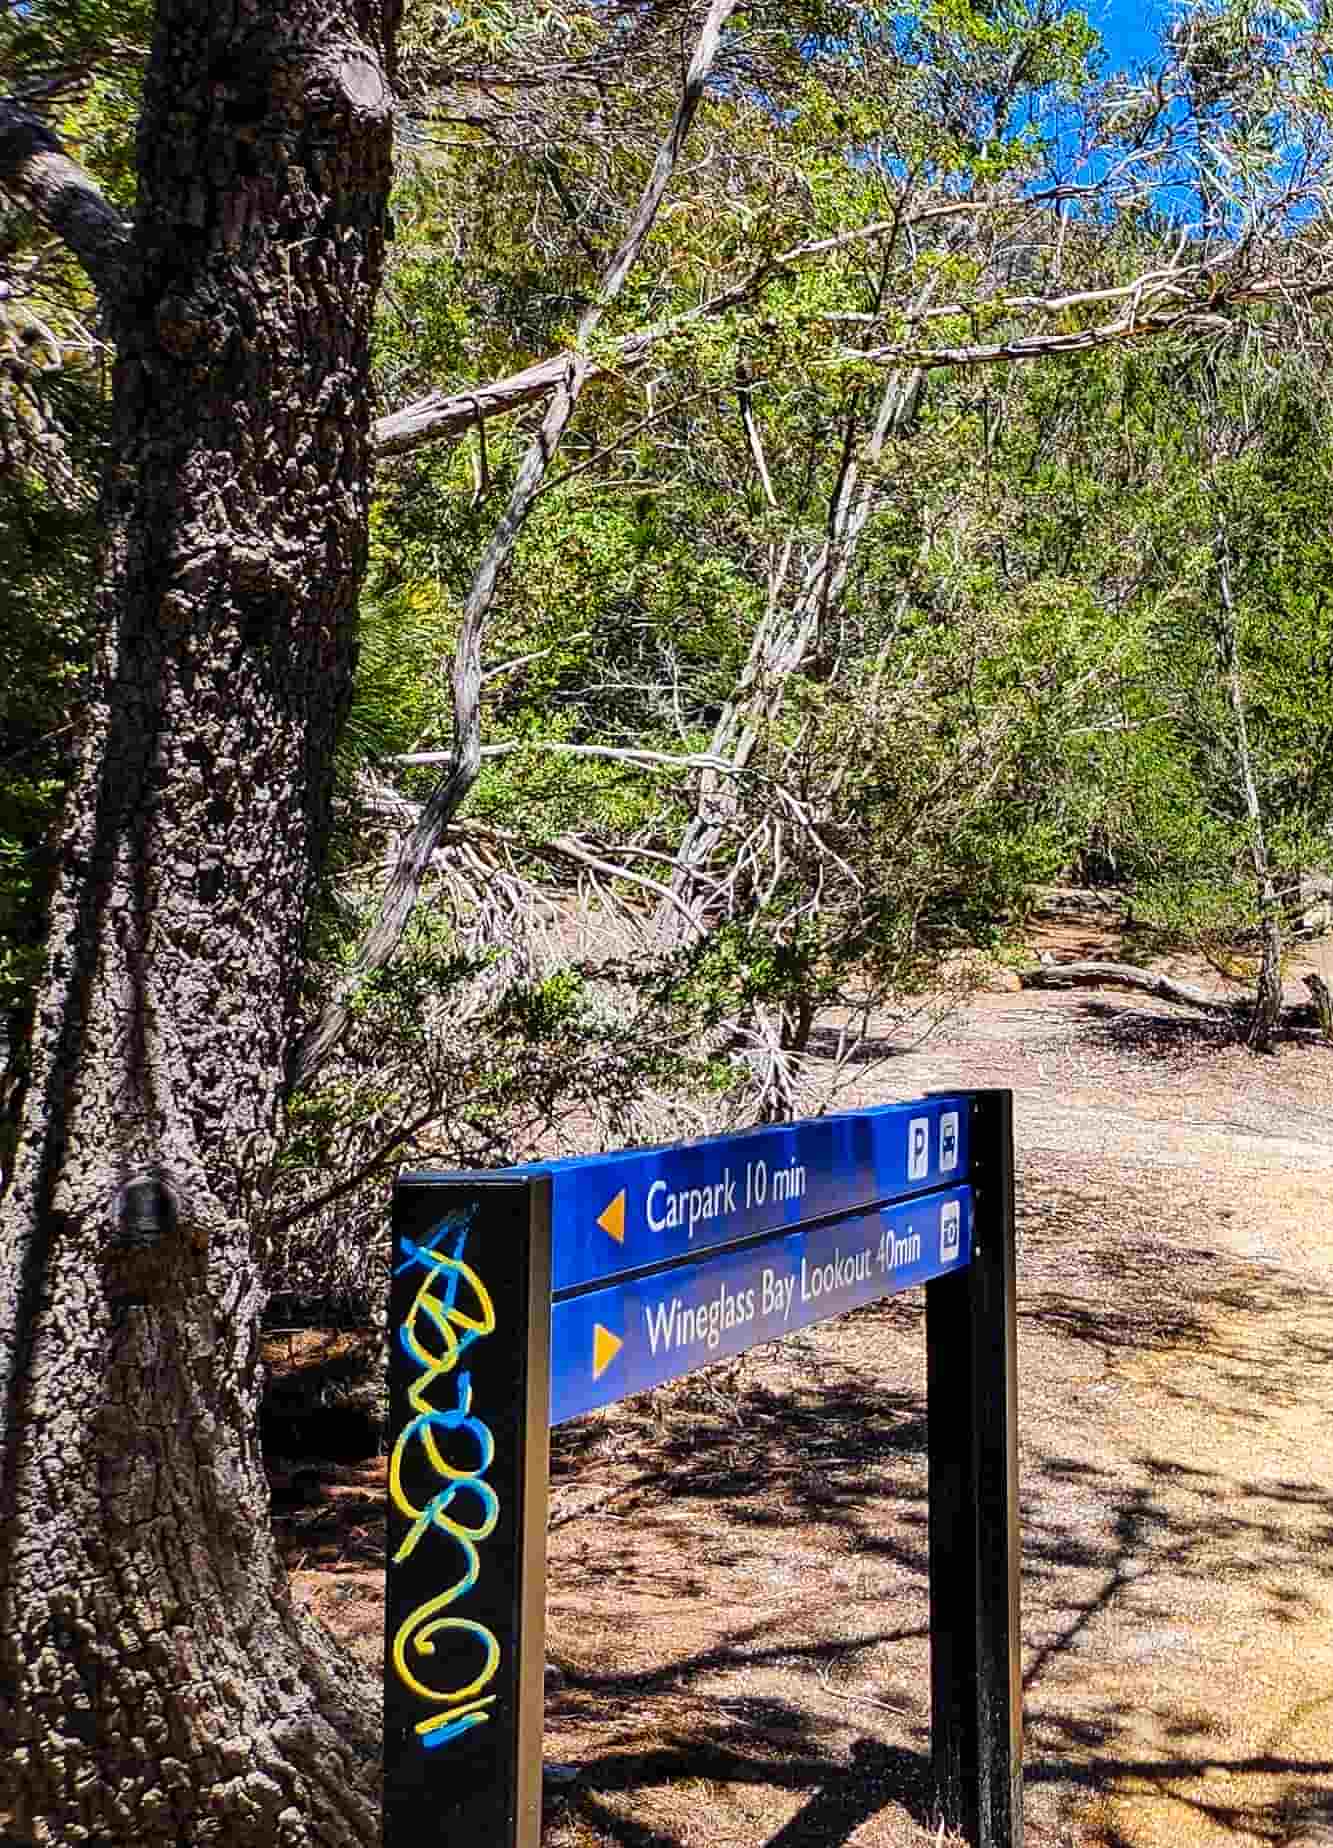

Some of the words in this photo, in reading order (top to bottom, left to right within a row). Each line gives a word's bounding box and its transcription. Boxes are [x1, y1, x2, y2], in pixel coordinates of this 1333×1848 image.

[646, 1168, 737, 1239] Carpark
[746, 1160, 767, 1209] 10
[772, 1156, 806, 1201] min
[645, 1282, 756, 1357] Wineglass
[760, 1268, 795, 1321] Bay
[800, 1248, 873, 1303] Lookout
